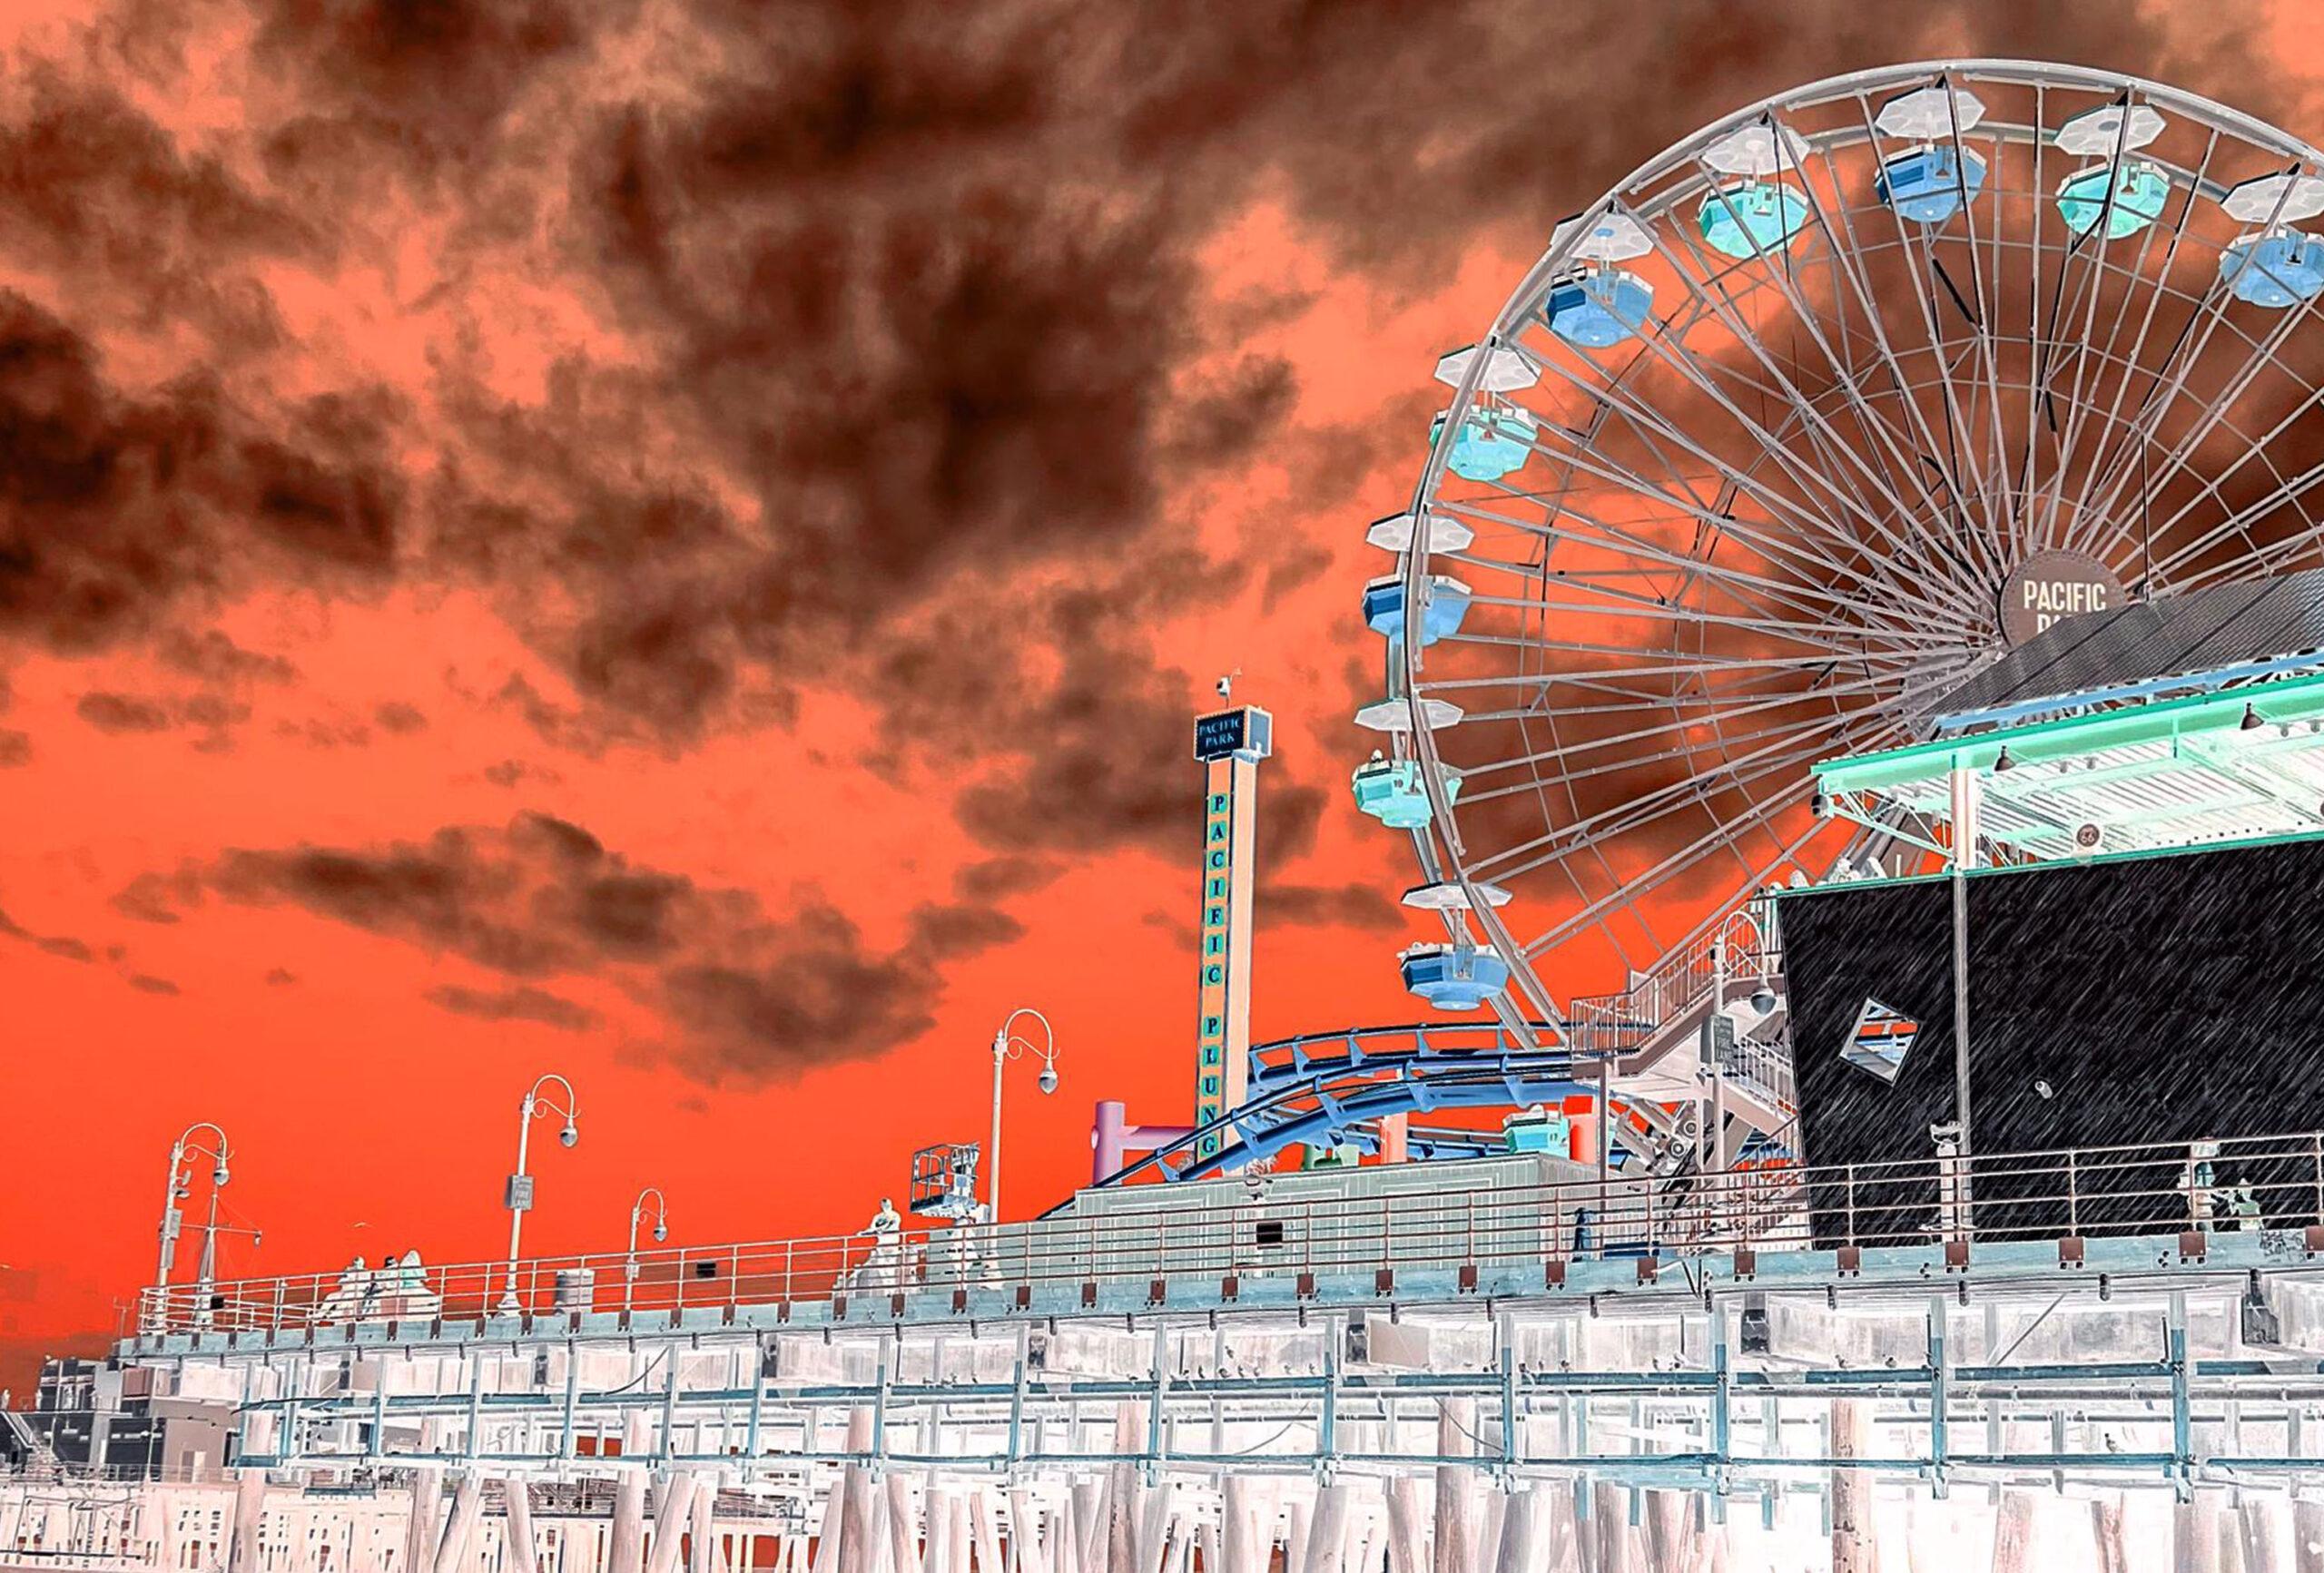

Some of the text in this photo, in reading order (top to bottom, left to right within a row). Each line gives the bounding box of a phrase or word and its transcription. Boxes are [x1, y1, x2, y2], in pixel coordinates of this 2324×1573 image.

[2024, 580, 2106, 613] PACIFIC
[1198, 718, 1239, 737] PACIFIC
[1206, 733, 1235, 748] PARK
[1207, 794, 1226, 984] PACIFIC
